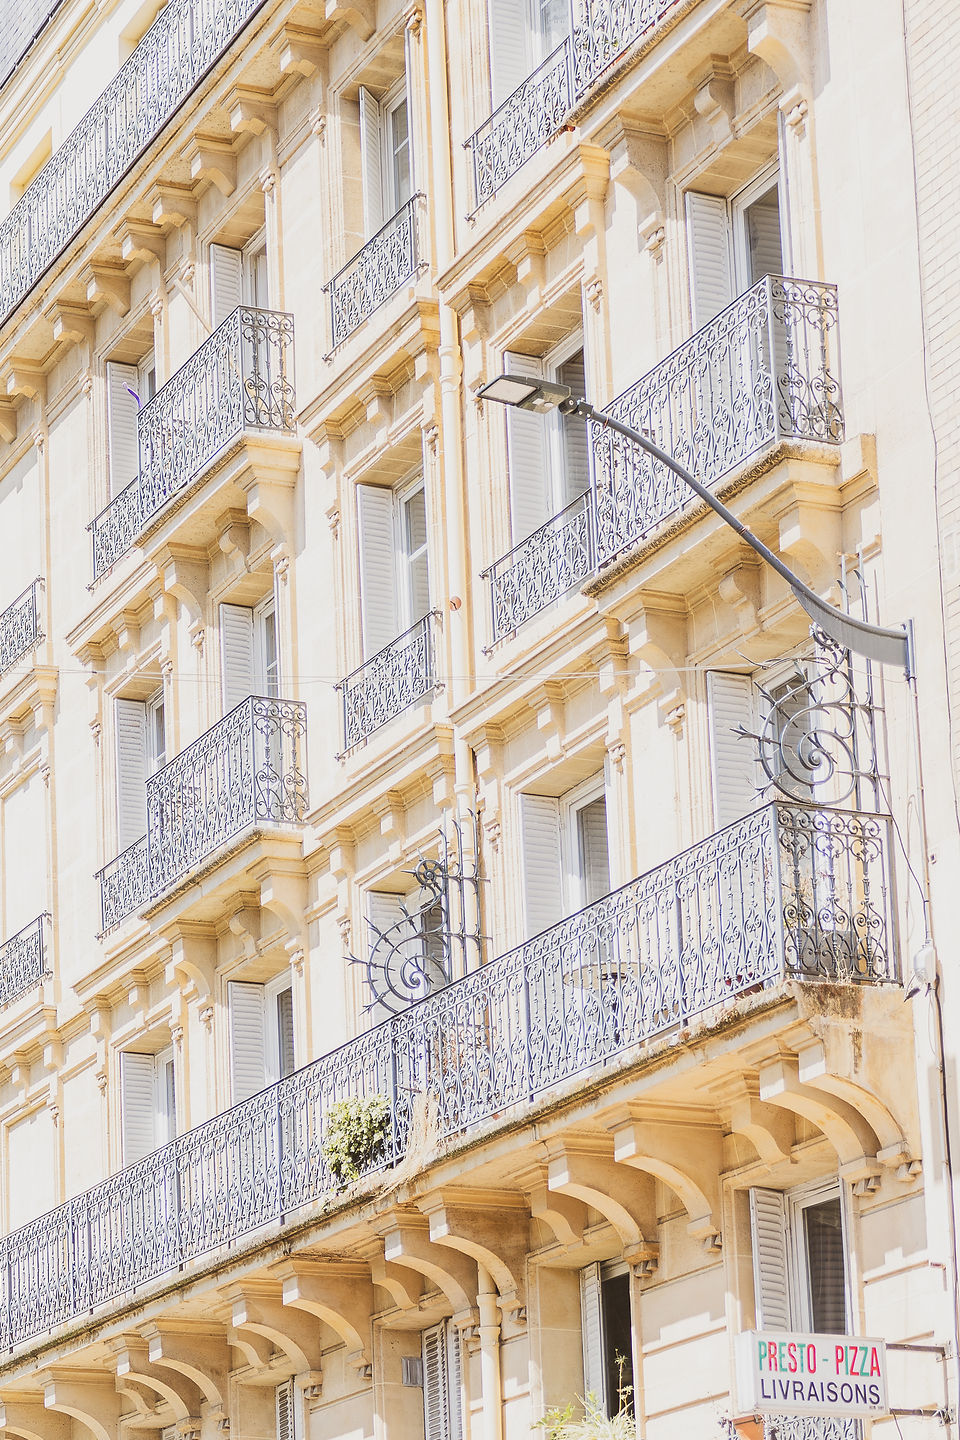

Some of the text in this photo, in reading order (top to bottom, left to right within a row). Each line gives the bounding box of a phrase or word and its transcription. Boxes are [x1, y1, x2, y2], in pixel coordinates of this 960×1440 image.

[758, 1341, 816, 1373] PRESTO
[835, 1345, 881, 1377] PIZZA
[760, 1378, 880, 1404] LIVRAISONS
